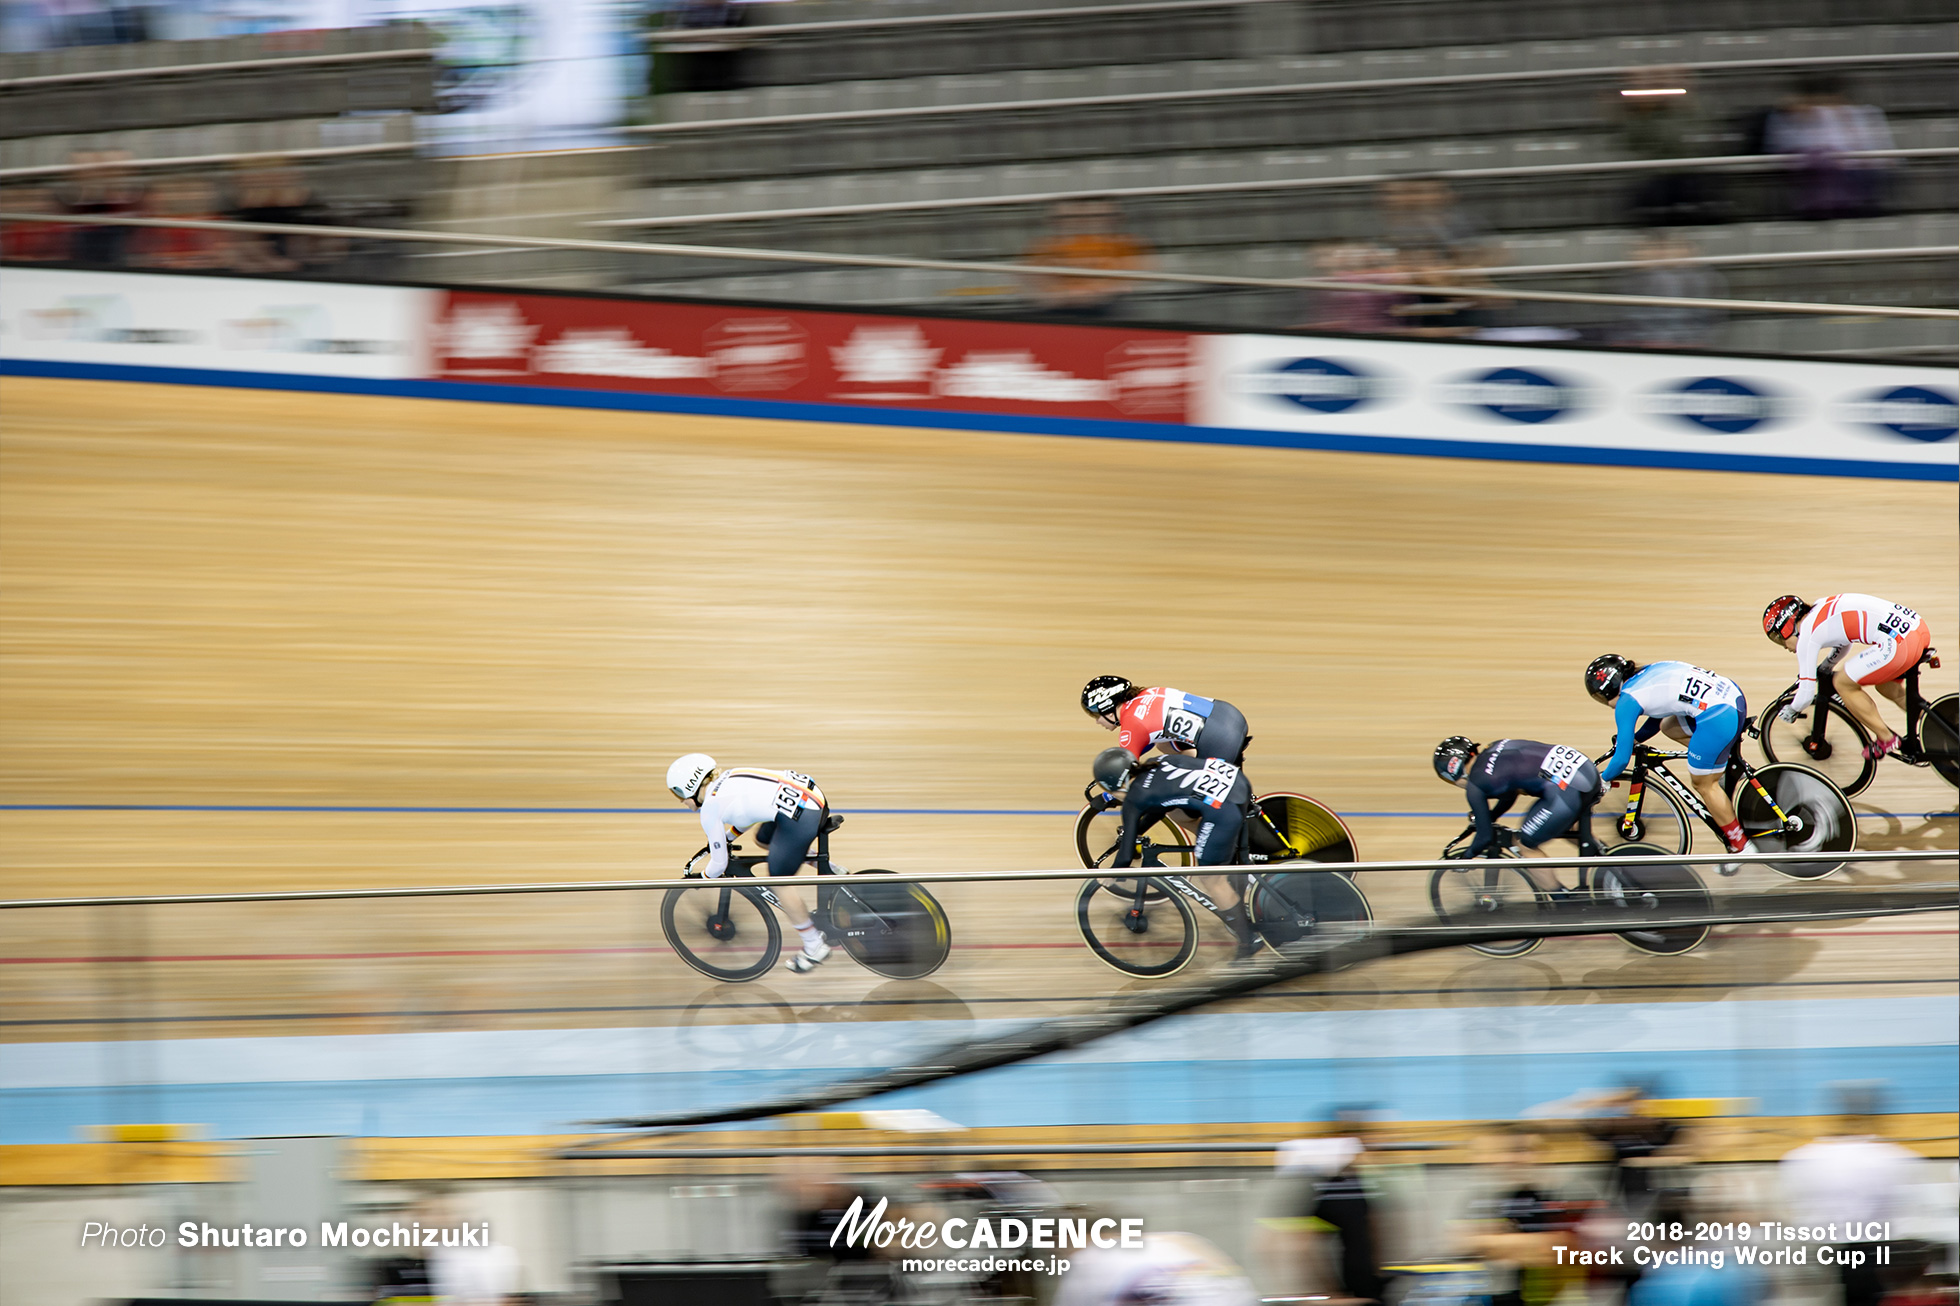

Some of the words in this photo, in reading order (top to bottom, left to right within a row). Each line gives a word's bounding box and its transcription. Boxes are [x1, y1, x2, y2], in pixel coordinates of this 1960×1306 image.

[1885, 612, 1910, 635] 189
[1685, 677, 1712, 699] 157
[1171, 716, 1193, 737] 62
[1556, 745, 1580, 764] 199
[1208, 760, 1235, 779] 227
[1549, 755, 1573, 779] 199
[1197, 774, 1229, 797] 227
[1654, 766, 1713, 819] LOOK
[775, 786, 800, 813] 150
